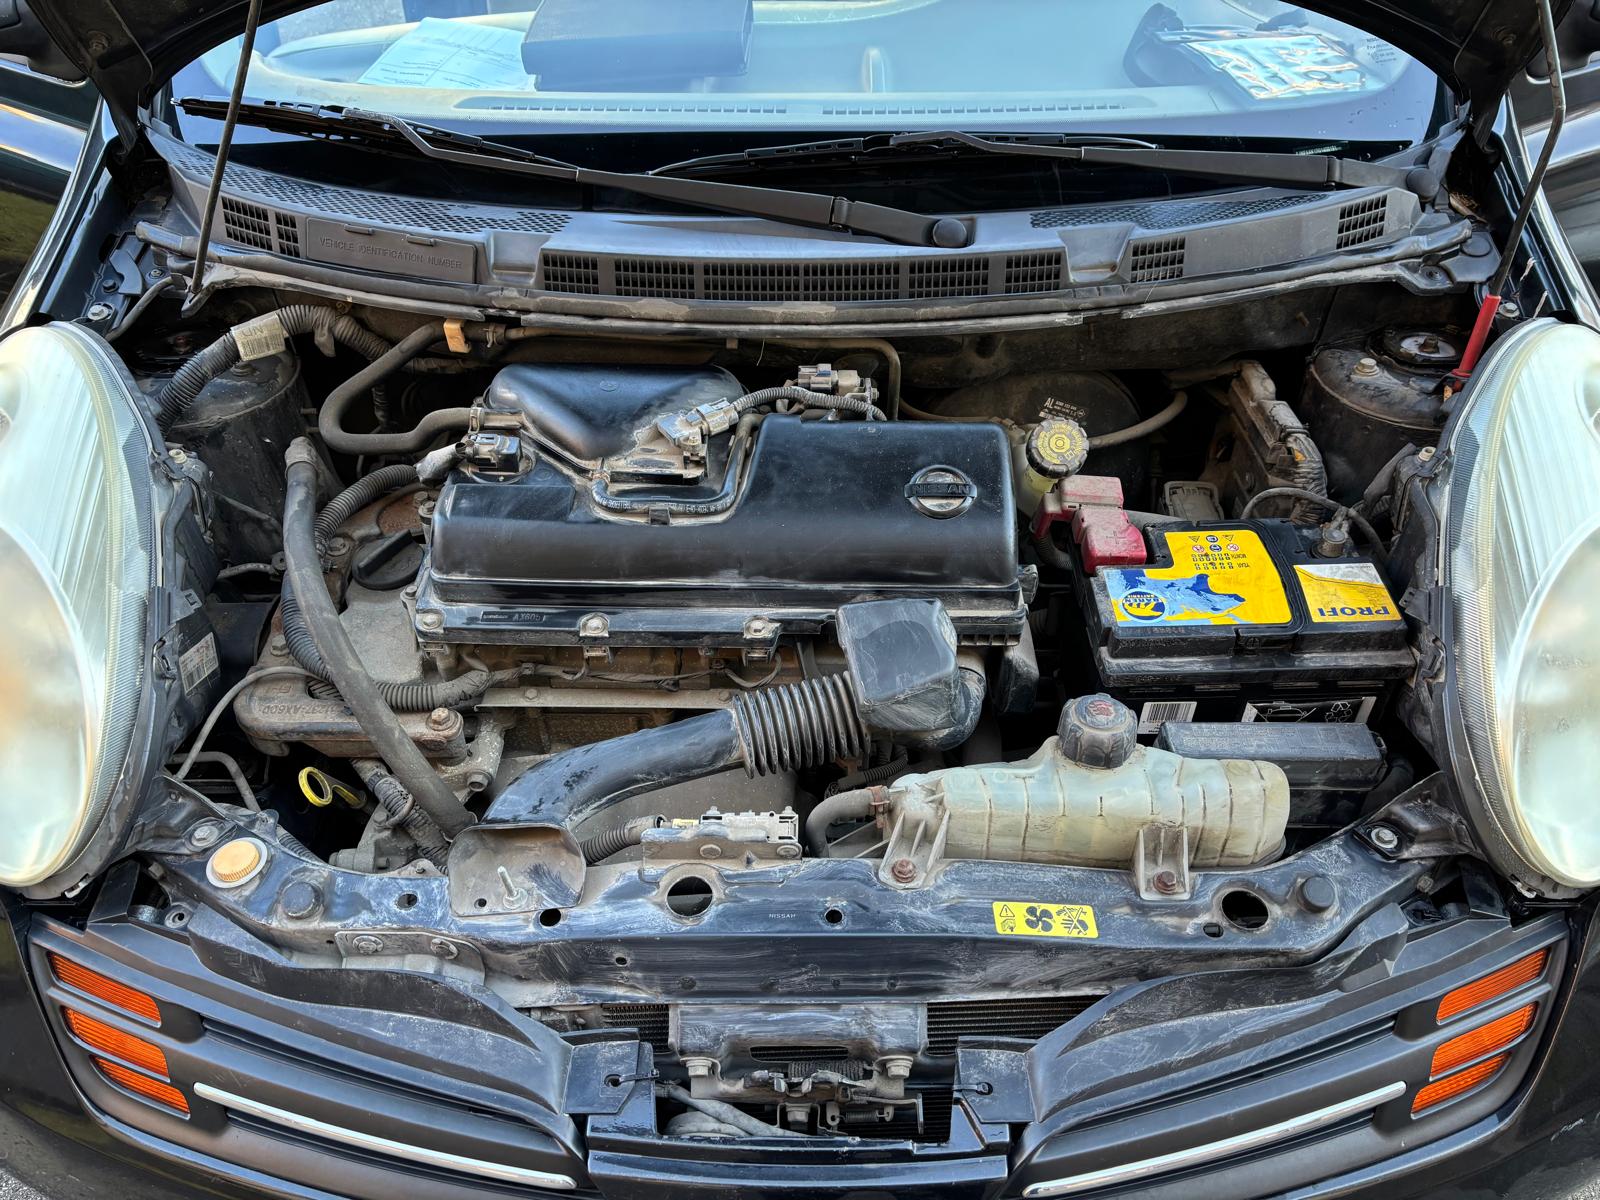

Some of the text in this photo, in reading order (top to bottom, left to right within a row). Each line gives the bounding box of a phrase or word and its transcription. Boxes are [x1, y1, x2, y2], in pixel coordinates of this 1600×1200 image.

[320, 237, 462, 269] VEHICLE IDENTIFICATION NUMBER
[912, 484, 970, 494] NISSAN
[1318, 606, 1390, 616] PROFI
